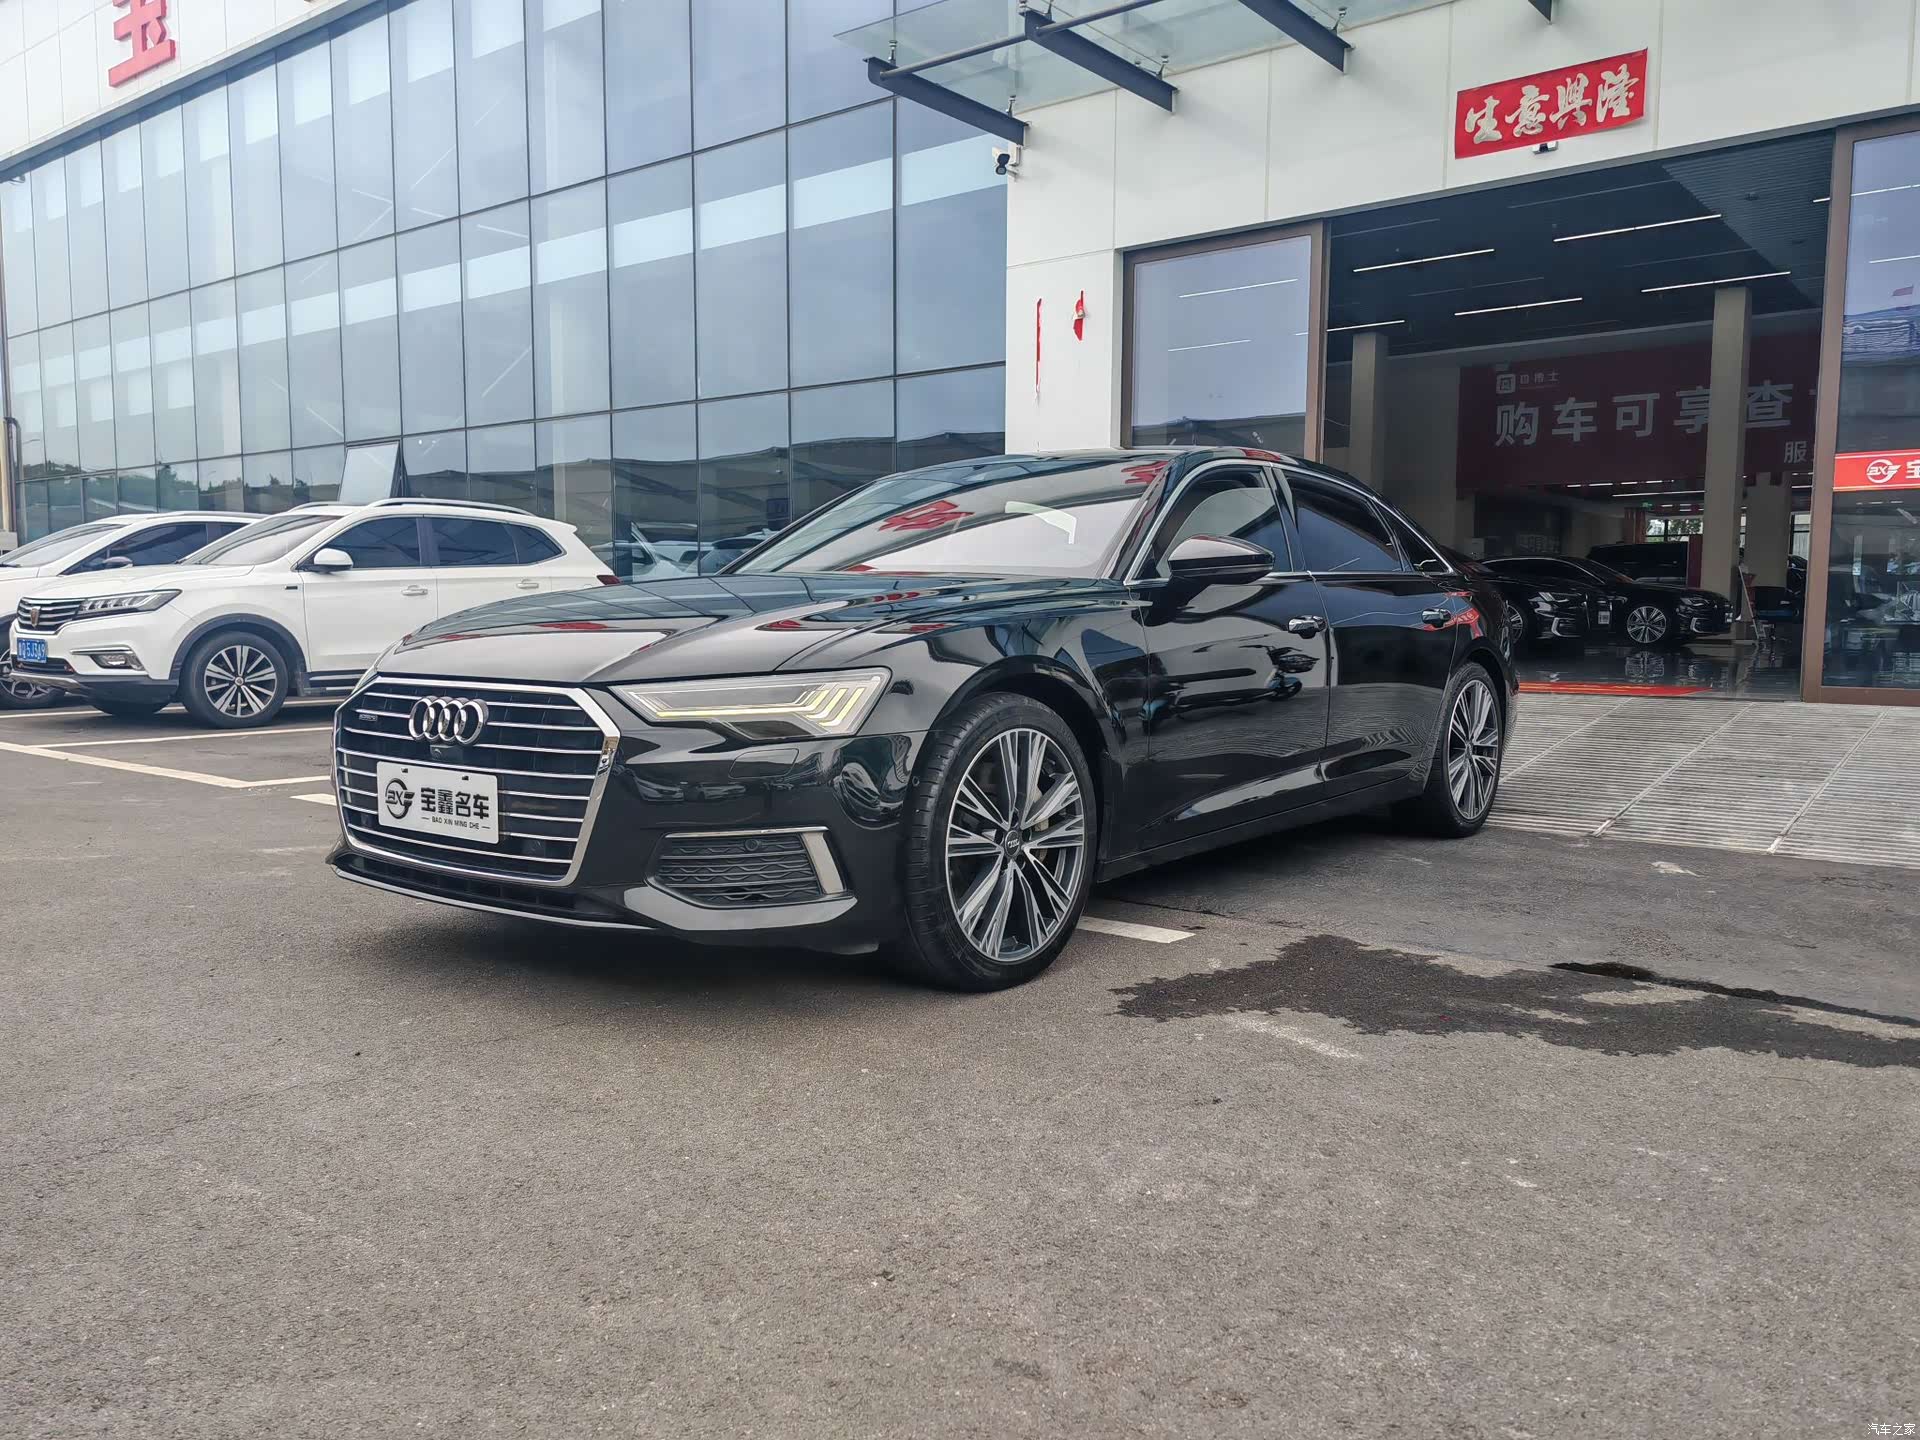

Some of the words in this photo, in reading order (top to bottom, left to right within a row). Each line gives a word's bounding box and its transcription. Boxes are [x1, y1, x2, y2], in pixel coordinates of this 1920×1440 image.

[1495, 380, 1818, 447] 购车可享查
[1784, 440, 1814, 464] 服
[420, 787, 490, 820] 宝鑫名车
[431, 816, 442, 824] BAO
[443, 818, 453, 826] XIN
[454, 820, 468, 828] MING
[469, 822, 480, 830] CHE
